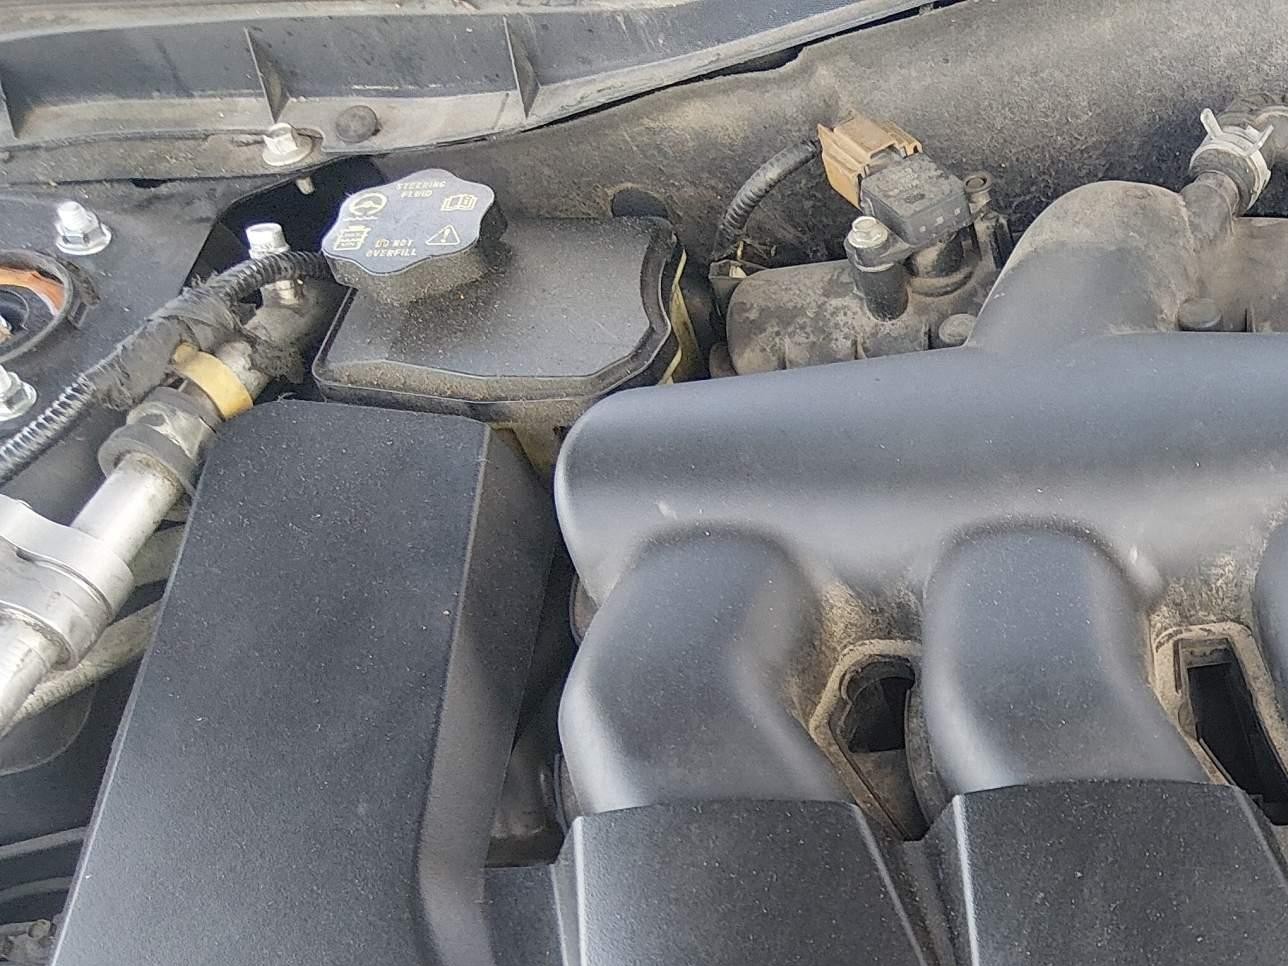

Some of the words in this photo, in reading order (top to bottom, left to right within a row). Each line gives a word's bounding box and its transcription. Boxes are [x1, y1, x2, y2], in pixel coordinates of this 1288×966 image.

[396, 180, 446, 191] STEERING
[401, 190, 433, 198] FLUID
[375, 240, 389, 248] DO
[366, 247, 417, 257] OVERFILL
